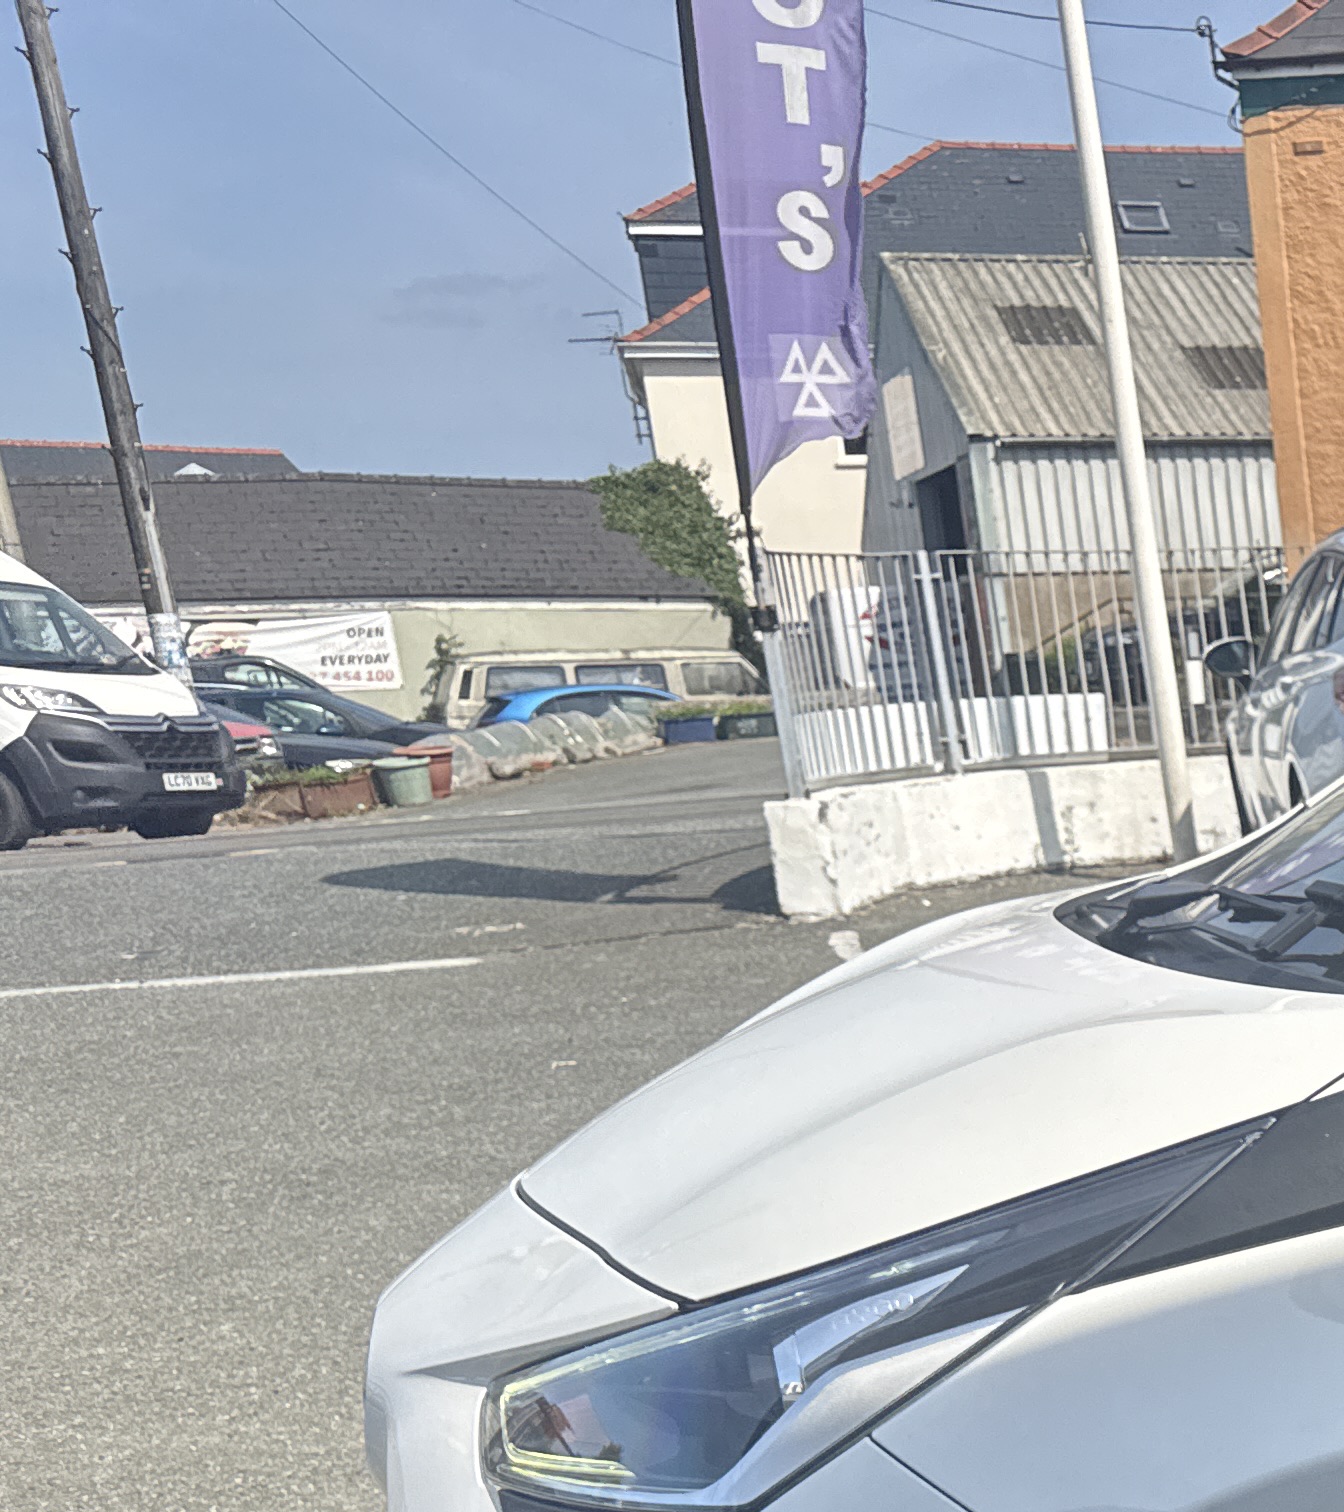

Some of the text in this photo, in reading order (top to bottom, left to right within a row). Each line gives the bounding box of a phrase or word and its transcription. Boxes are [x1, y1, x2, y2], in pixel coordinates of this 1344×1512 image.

[346, 627, 384, 638] OPEN
[320, 653, 391, 666] EVERYDAY
[366, 670, 395, 681] 100
